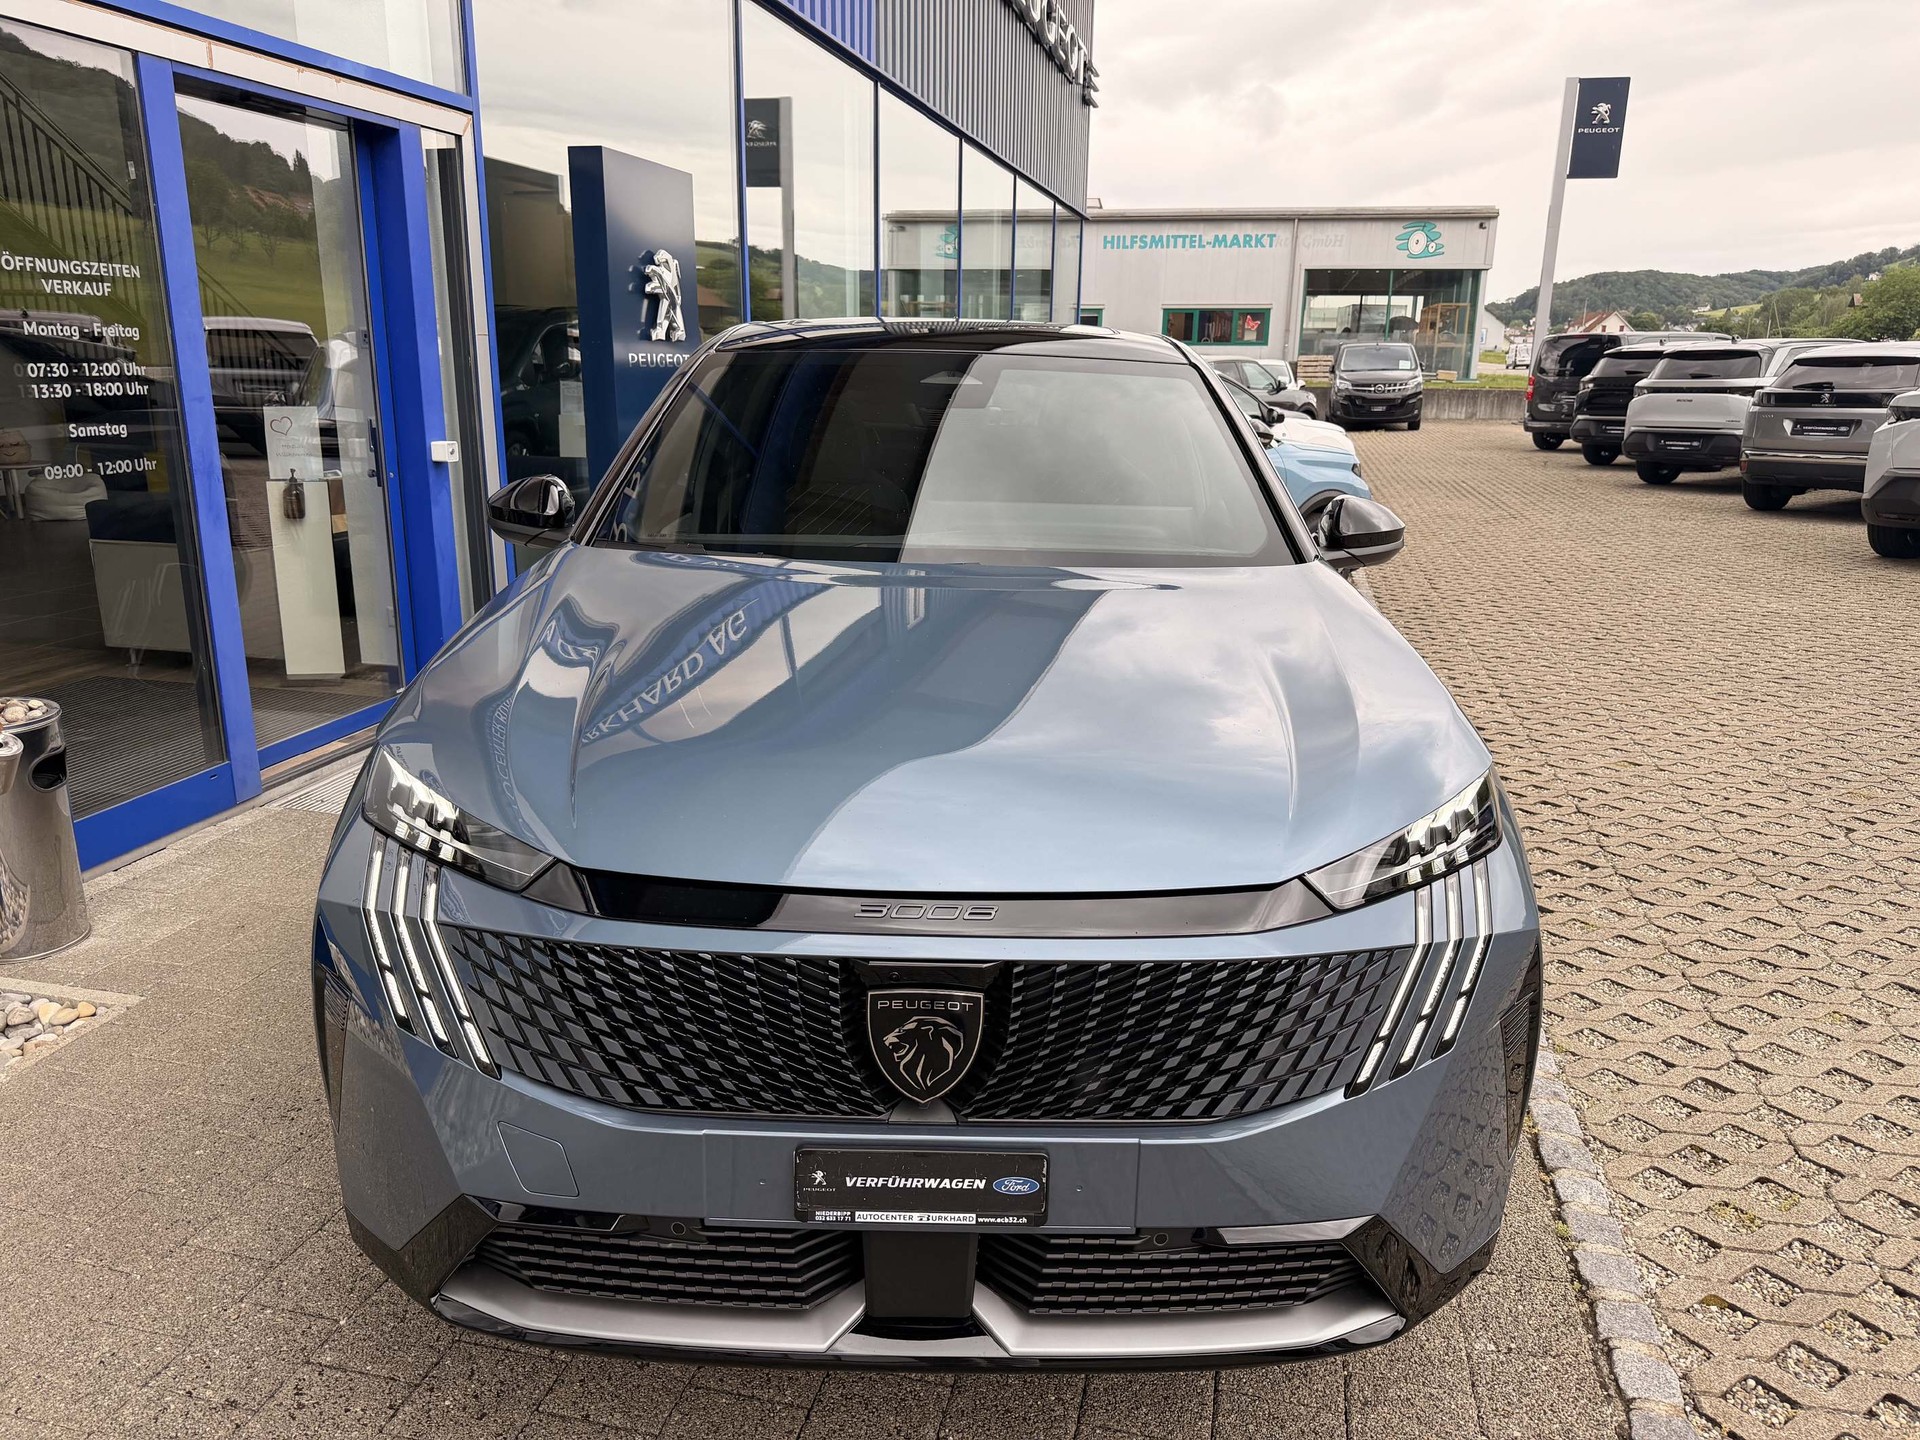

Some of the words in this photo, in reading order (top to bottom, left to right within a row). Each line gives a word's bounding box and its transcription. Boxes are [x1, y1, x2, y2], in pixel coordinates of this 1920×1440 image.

[1102, 233, 1276, 250] HILFSMITTEL-MARKT
[1, 251, 140, 278] ÖFFNUNGSZEITEN
[41, 279, 112, 297] VERKAUF
[23, 321, 79, 340] Montag
[94, 323, 140, 341] Freitag
[27, 363, 69, 378] 07:30
[84, 363, 121, 377] 12:00
[124, 362, 146, 377] Uhr
[32, 384, 72, 399] 13:30
[86, 383, 123, 397] 18:00
[126, 382, 149, 396] Uhr
[69, 423, 128, 438] Samstag
[44, 463, 84, 481] 09:00
[98, 460, 133, 476] 12:00
[134, 458, 157, 473] Uhr
[854, 904, 999, 920] 3008
[877, 1000, 974, 1012] PEUGEOT
[845, 1175, 987, 1191] VERFÜHRWAGEN
[1001, 1179, 1031, 1192] Ford
[856, 1213, 914, 1221] AUTOCENTER
